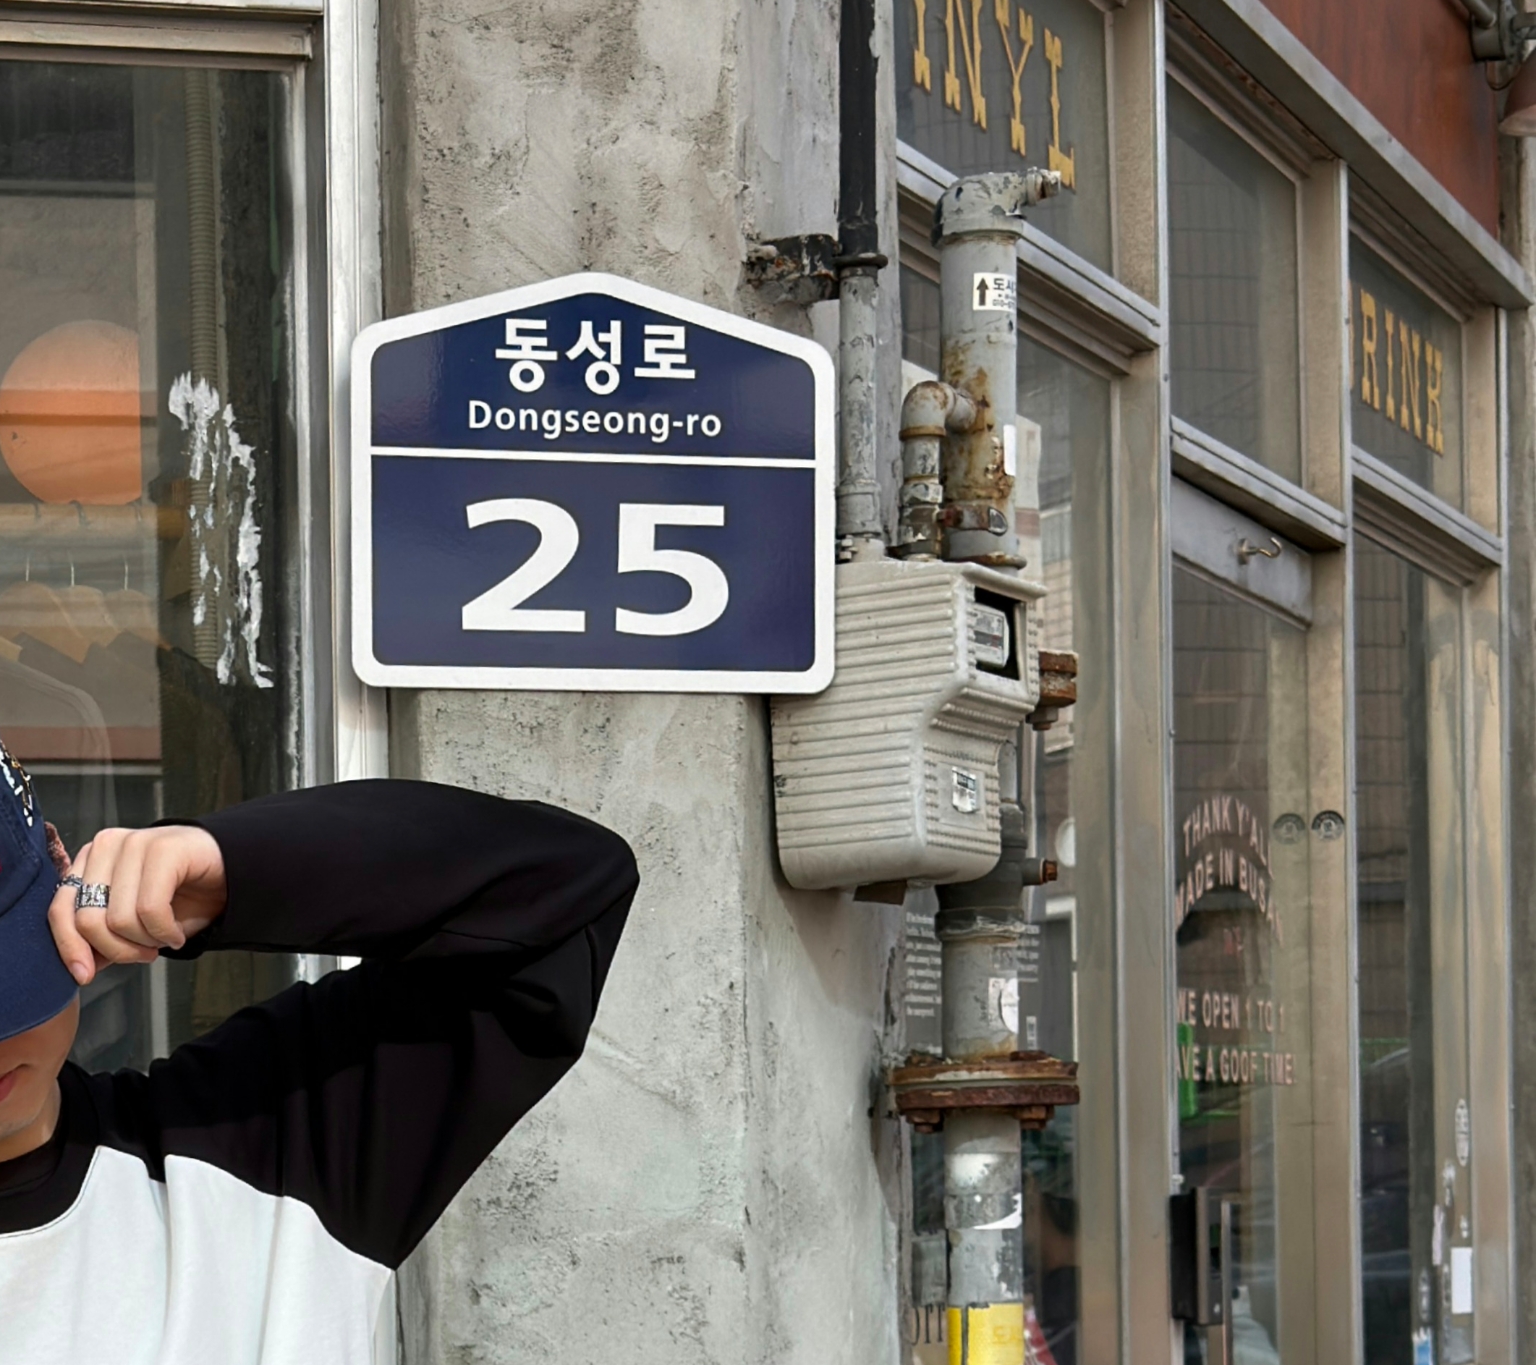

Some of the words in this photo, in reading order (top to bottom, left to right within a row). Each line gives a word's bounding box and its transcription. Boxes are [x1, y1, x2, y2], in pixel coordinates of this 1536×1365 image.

[495, 318, 695, 395] 동성로
[1348, 280, 1443, 457] RINK
[468, 400, 722, 443] Dongseong-ro
[462, 498, 729, 636] 25
[1182, 795, 1232, 857] THANK
[1219, 848, 1233, 886] IN
[1202, 989, 1240, 1030] OPEN
